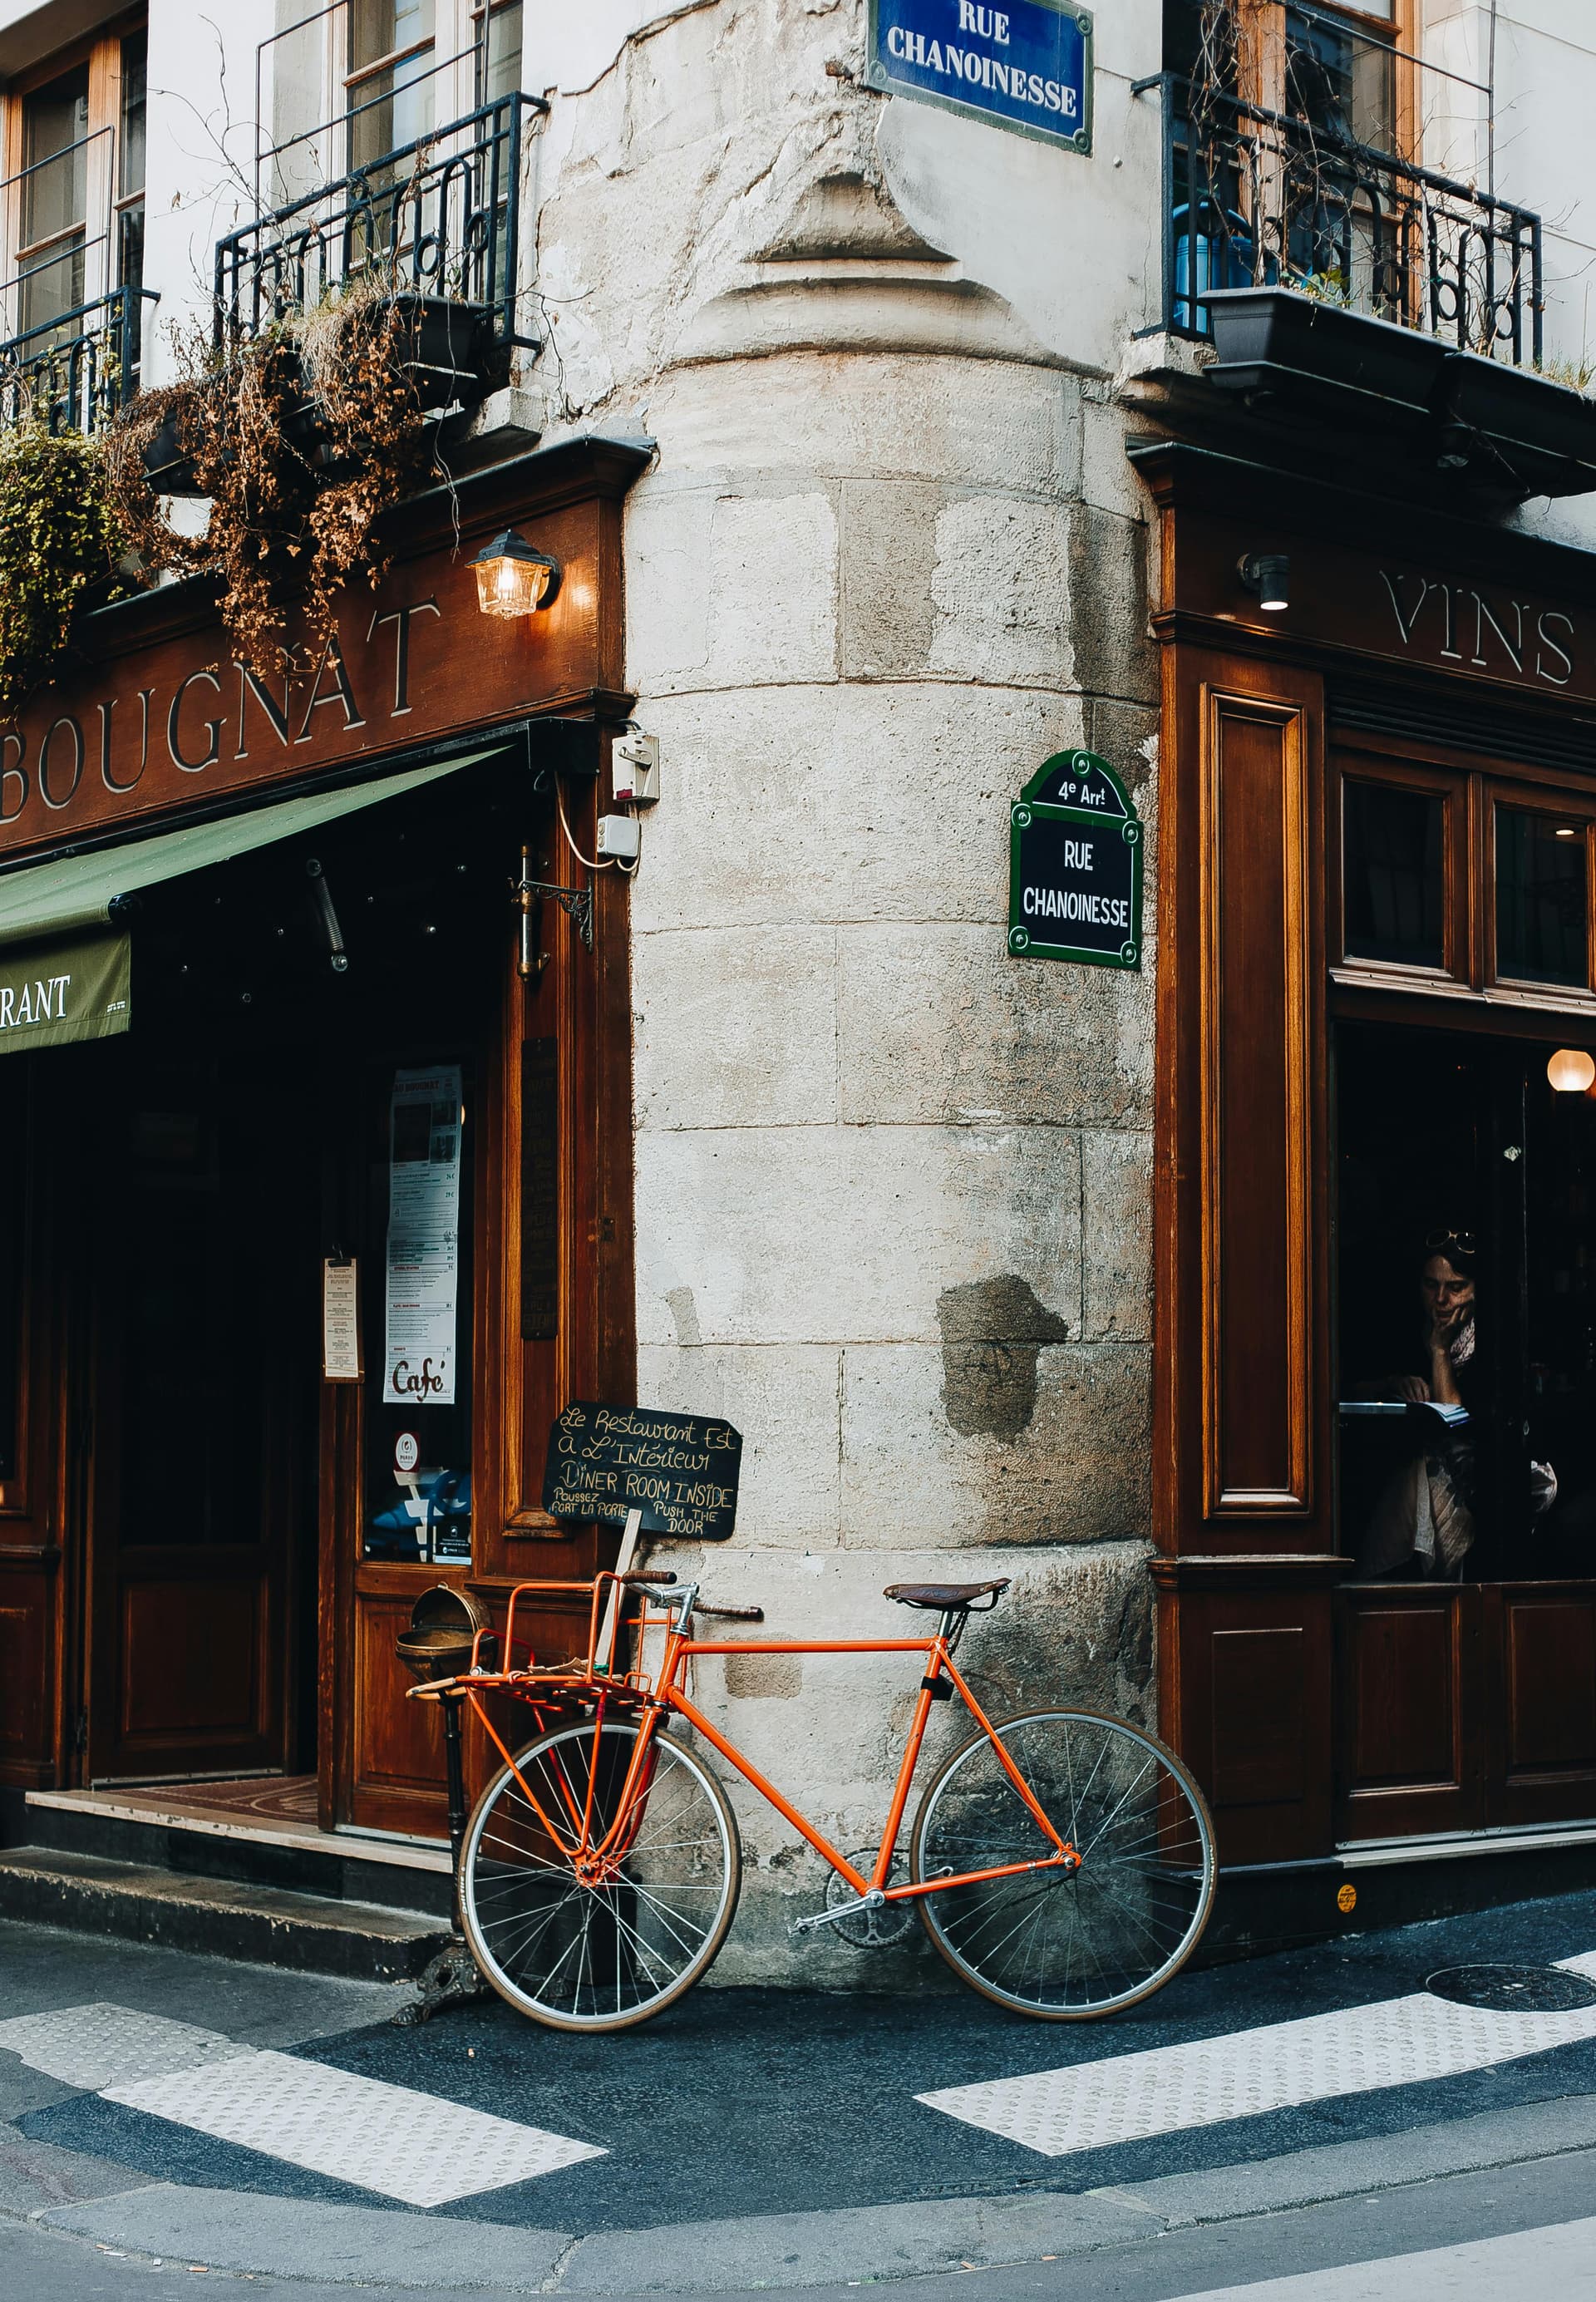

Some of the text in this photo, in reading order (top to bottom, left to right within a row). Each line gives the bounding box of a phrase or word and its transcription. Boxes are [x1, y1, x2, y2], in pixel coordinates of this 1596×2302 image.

[958, 0, 1010, 45] RUE
[887, 26, 1077, 118] CHANOINESSE
[1378, 569, 1574, 685] VINS
[1064, 840, 1094, 871] RUE
[1023, 886, 1129, 928] CHANOINESSE
[392, 1358, 446, 1402] Café
[559, 1407, 586, 1427] Le
[595, 1409, 697, 1445] Restaurant
[625, 1472, 671, 1501] ROOM
[581, 1502, 595, 1515] LA
[597, 1501, 630, 1519] PORTE
[653, 1500, 720, 1522] PUSH THE
[666, 1517, 704, 1535] DOOR
